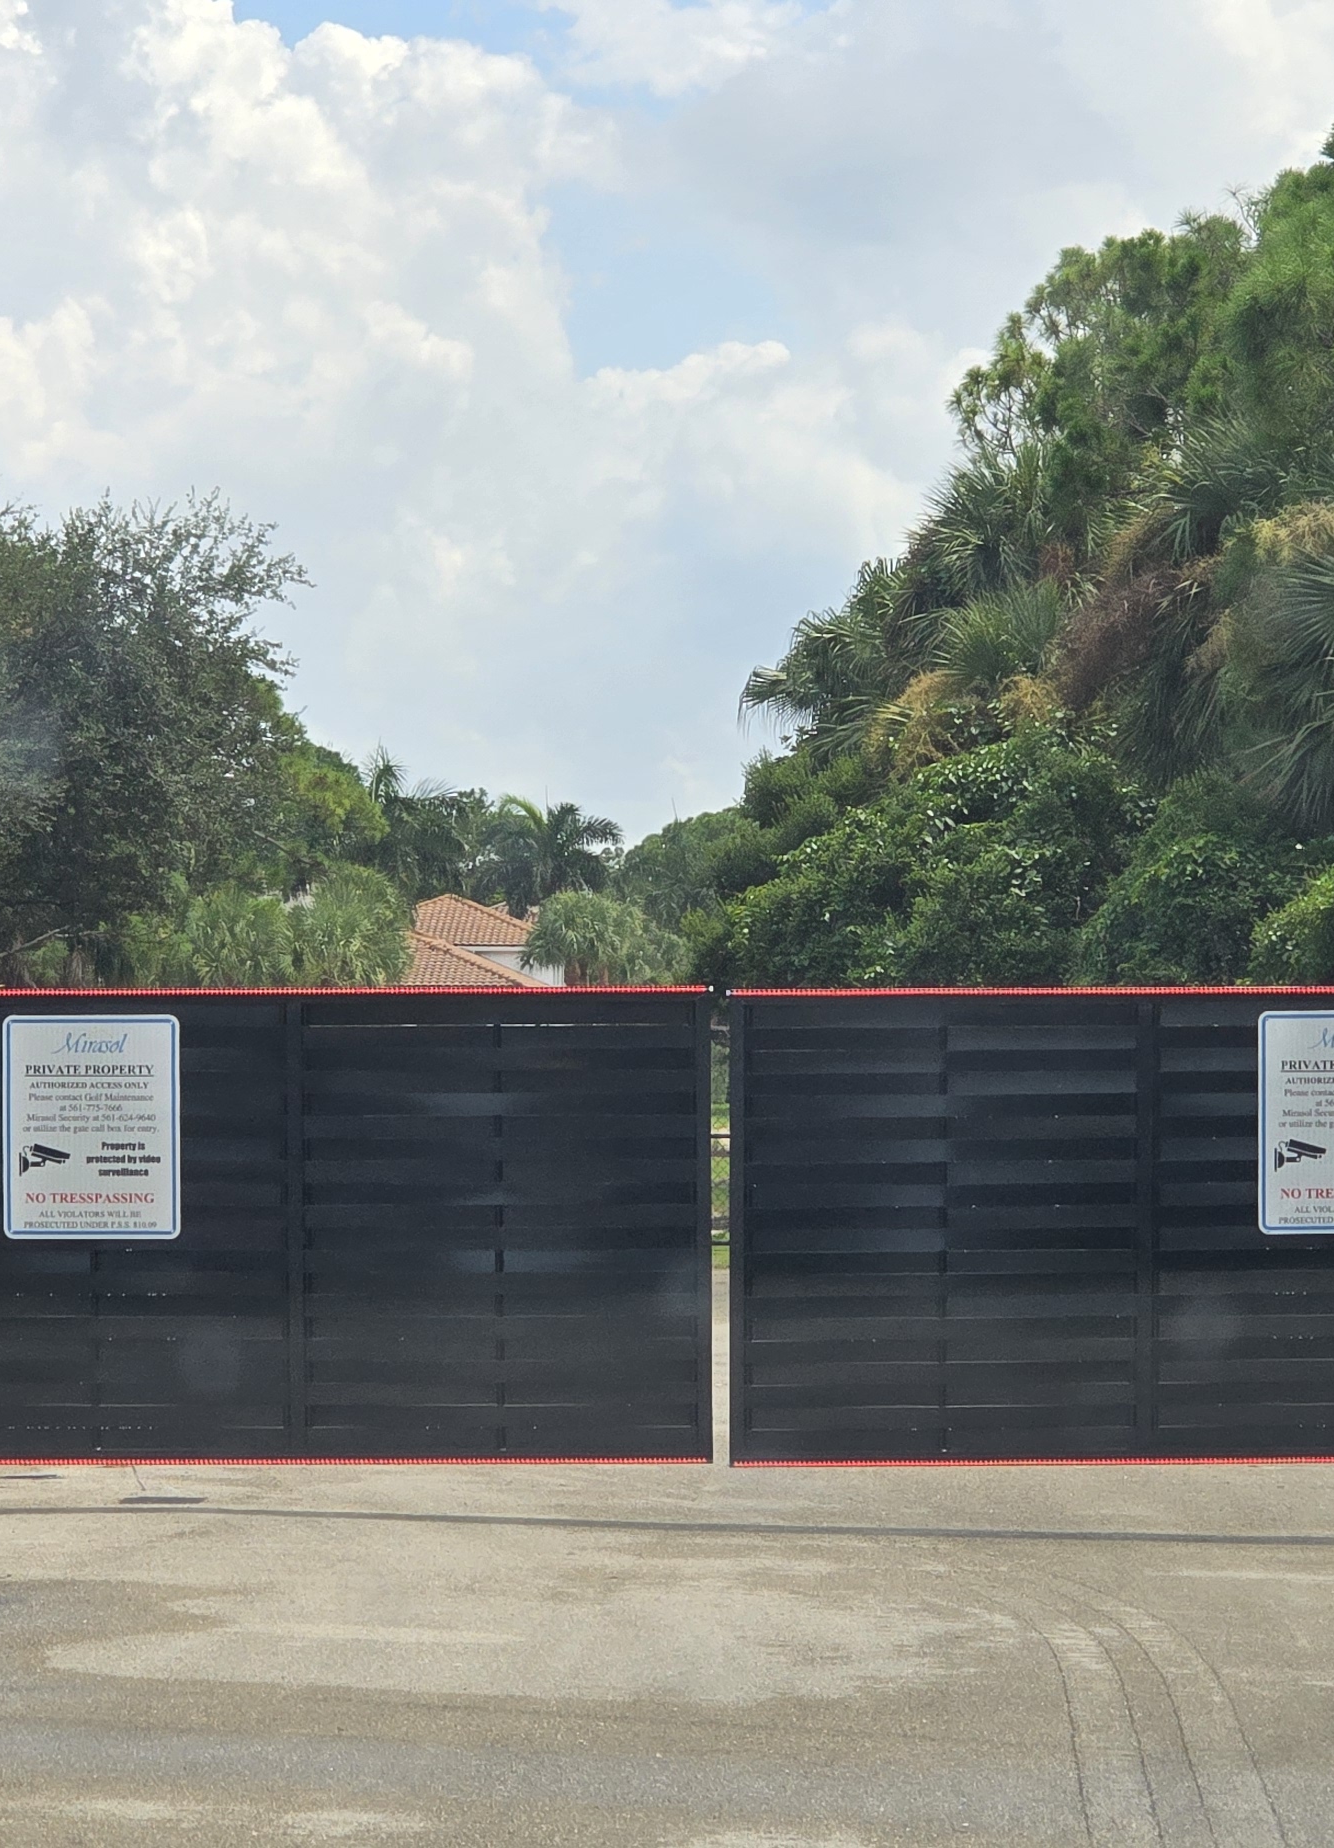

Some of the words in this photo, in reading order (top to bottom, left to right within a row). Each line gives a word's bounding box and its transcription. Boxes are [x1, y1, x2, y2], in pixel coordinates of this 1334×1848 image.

[52, 1032, 128, 1054] Mirasol
[25, 1065, 81, 1076] PRIVATE
[85, 1065, 154, 1076] PROPERTY
[28, 1093, 53, 1101] Please
[85, 1093, 102, 1101] Golf
[105, 1093, 154, 1101] Maintenance
[1282, 1109, 1313, 1117] Mirasol
[59, 1114, 91, 1123] Security
[1289, 1120, 1313, 1128] utilize
[73, 1125, 88, 1134] gate
[137, 1125, 159, 1134] entry.
[102, 1142, 136, 1151] Property
[138, 1142, 145, 1151] is
[87, 1155, 125, 1164] protected
[127, 1155, 137, 1164] by
[139, 1155, 161, 1164] video
[99, 1168, 149, 1176] surveillance
[25, 1193, 46, 1203] NO
[50, 1193, 154, 1203] TRESSPASSING
[1280, 1188, 1301, 1199] NO
[1279, 1216, 1334, 1224] PROSECUTED
[24, 1221, 79, 1229] PROSECUTED
[81, 1221, 109, 1229] UNDER
